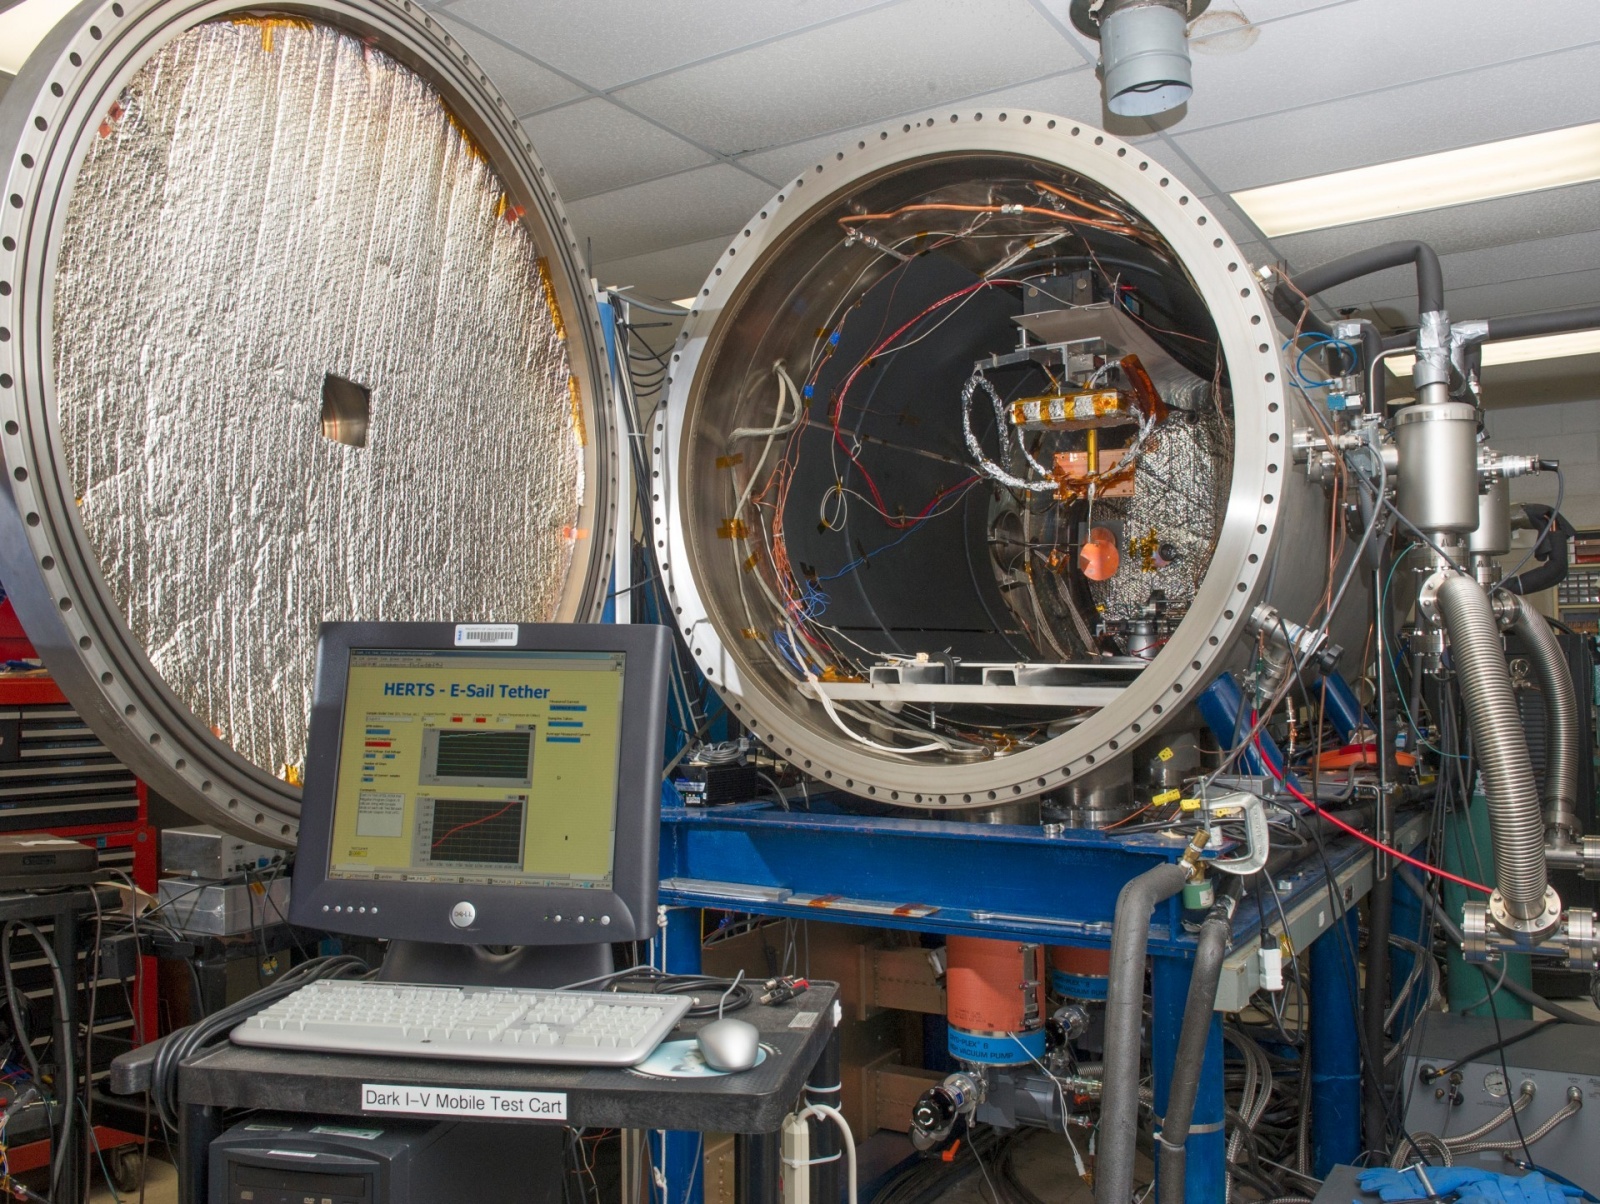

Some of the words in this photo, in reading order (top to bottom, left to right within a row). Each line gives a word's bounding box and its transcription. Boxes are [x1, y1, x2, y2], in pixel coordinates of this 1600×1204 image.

[384, 682, 435, 697] HERTS
[450, 683, 494, 698] E-Sail
[500, 684, 550, 699] Tether
[960, 1048, 988, 1058] VACUUM
[366, 1090, 400, 1106] Dark
[436, 1093, 485, 1110] Mobile
[490, 1096, 524, 1112] Test
[529, 1097, 562, 1114] Cart
